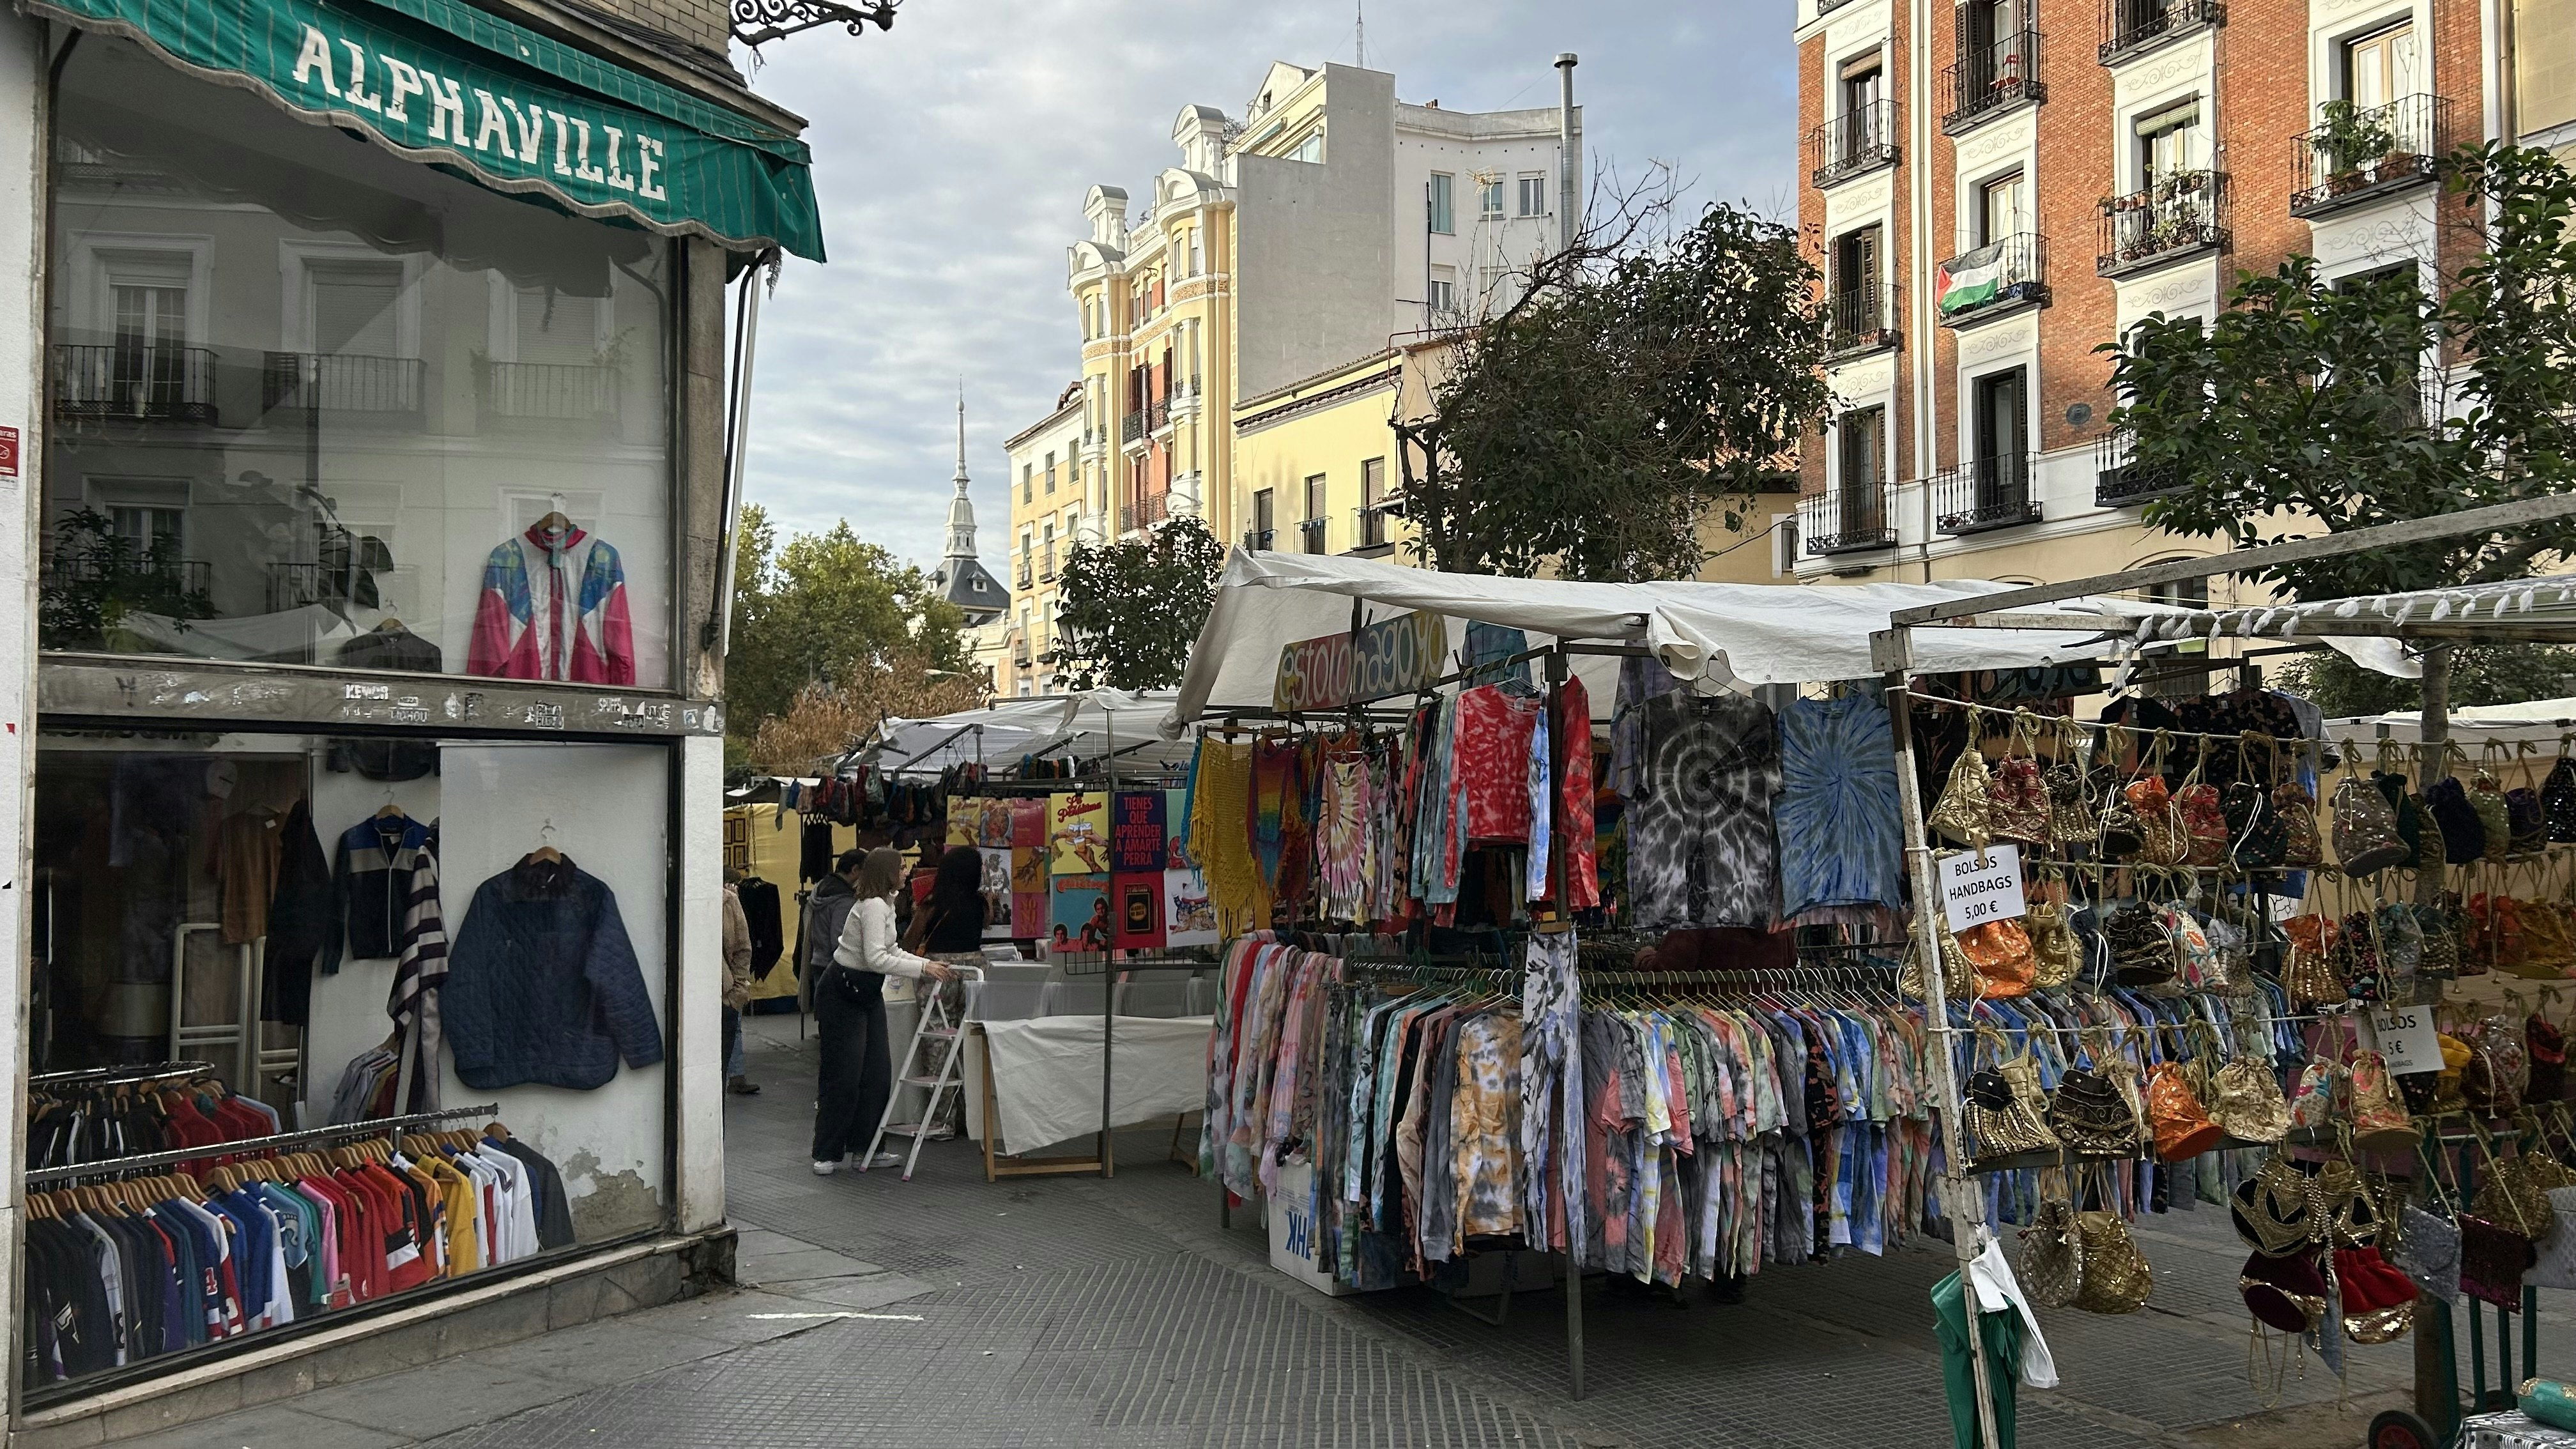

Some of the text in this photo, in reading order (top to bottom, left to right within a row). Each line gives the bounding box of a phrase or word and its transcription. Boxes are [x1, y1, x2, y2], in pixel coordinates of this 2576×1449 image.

[292, 22, 667, 203] ALPHAVILLE
[1124, 797, 1153, 811] TIENES
[1129, 811, 1148, 825] QUE
[1115, 825, 1161, 839] APRENDER
[1116, 838, 1161, 853] A AMARTE
[1123, 852, 1153, 866] PERRA
[1955, 855, 1997, 877] BOLSOS
[1949, 875, 2012, 901] HANDBAGS
[1965, 900, 1998, 920] 5,00 €
[2377, 1015, 2417, 1032] BOLSOS
[2388, 1040, 2404, 1055] 5 €
